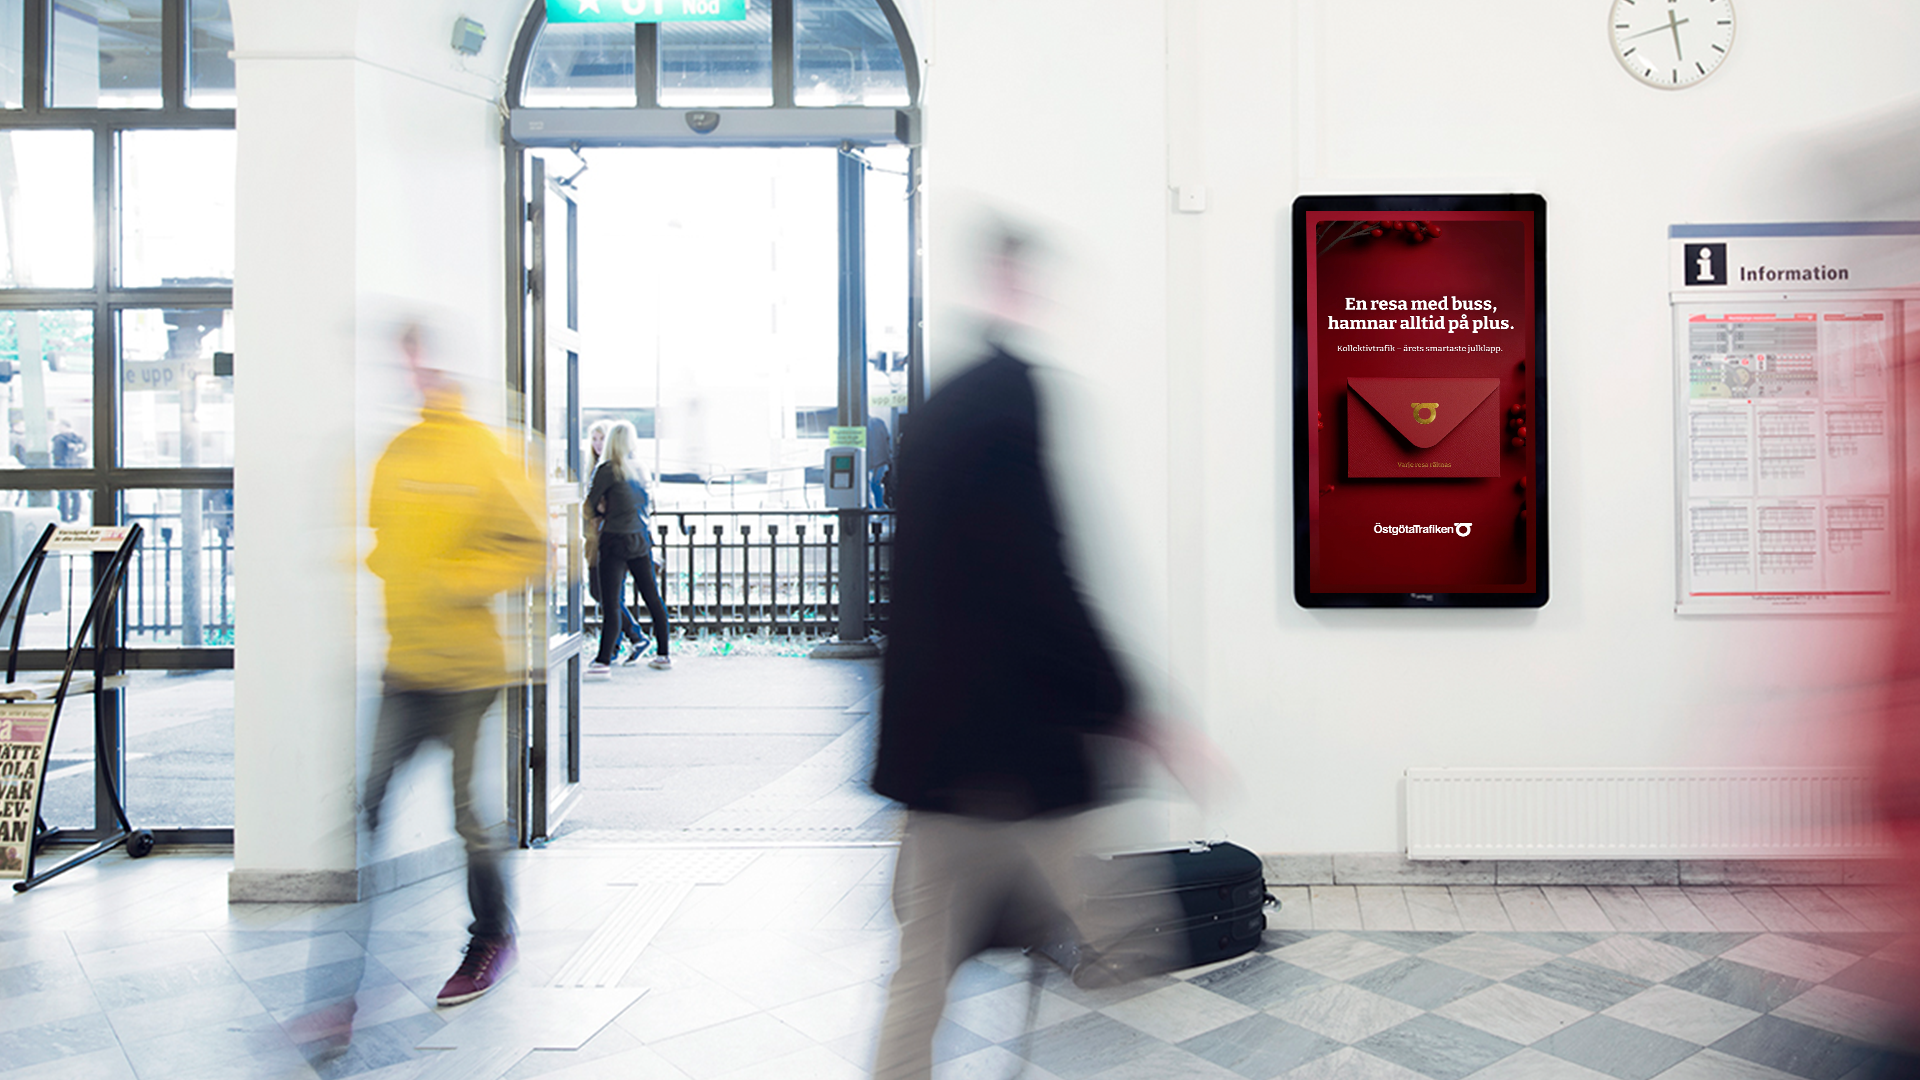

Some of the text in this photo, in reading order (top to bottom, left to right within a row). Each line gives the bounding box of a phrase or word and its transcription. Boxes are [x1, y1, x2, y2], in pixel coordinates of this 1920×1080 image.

[1740, 265, 1849, 282] Information
[1345, 295, 1497, 314] En resa med buss,
[1328, 313, 1515, 333] hamnar alltid på plus.
[1337, 344, 1395, 352] Kollektivtrafik
[1403, 344, 1424, 352] årets
[1467, 344, 1503, 354] julklapp.
[142, 367, 173, 387] upp
[1373, 522, 1454, 536] ÖstgötaTrafiken
[0, 743, 41, 760] ÄTTE
[0, 760, 35, 779] OLA
[0, 801, 29, 818] EV-
